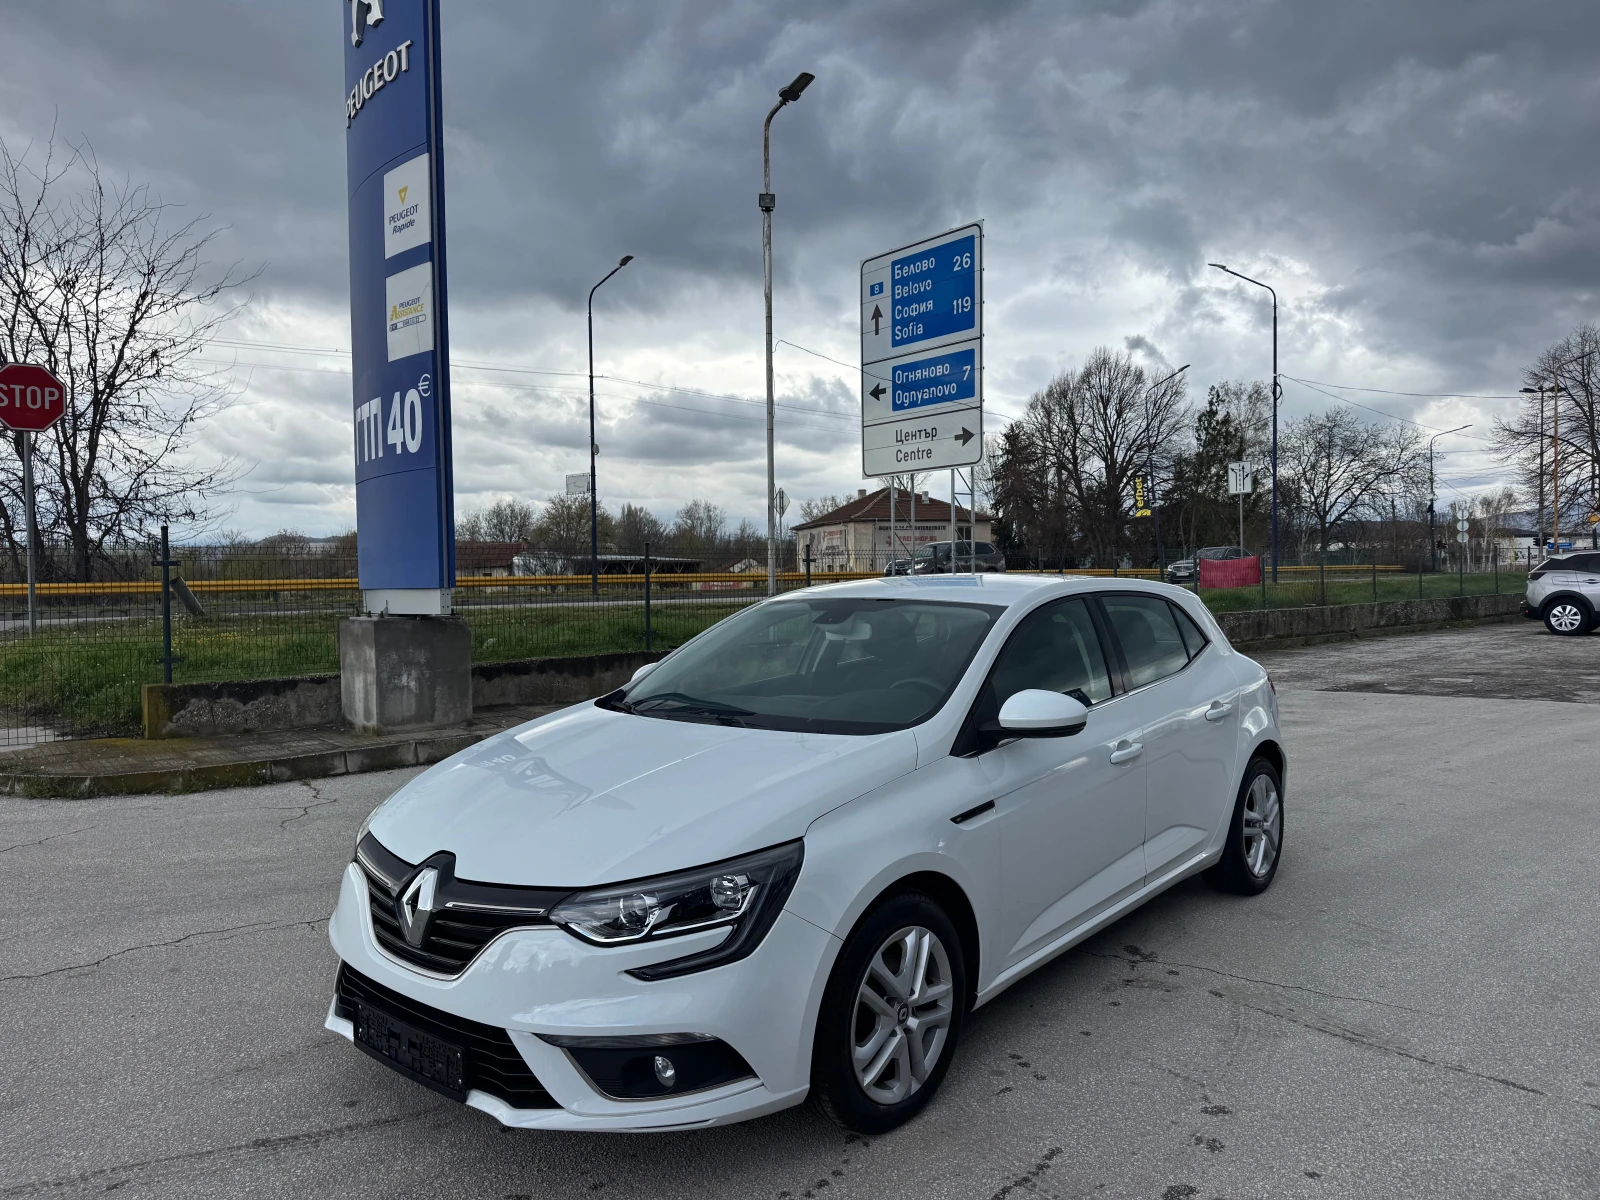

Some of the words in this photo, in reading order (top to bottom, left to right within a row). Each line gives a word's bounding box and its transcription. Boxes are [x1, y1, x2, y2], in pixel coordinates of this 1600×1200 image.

[346, 40, 412, 128] PEUGEOT
[389, 204, 419, 225] PEUGEOT
[392, 218, 415, 234] Rapide
[895, 257, 935, 279] Белово
[953, 252, 971, 272] 26
[874, 284, 880, 294] 8
[895, 279, 932, 299] Belovo
[399, 296, 421, 309] PEUGEOT
[895, 300, 934, 320] София
[953, 296, 971, 315] 119
[895, 322, 924, 340] Sofia
[895, 363, 950, 384] Огняново
[963, 365, 971, 381] 7
[0, 384, 59, 410] STOP
[895, 383, 957, 406] Ognyanovo
[355, 396, 384, 466] ГТП
[895, 427, 938, 445] Център
[895, 446, 933, 463] Centre
[1135, 476, 1144, 508] efbet
